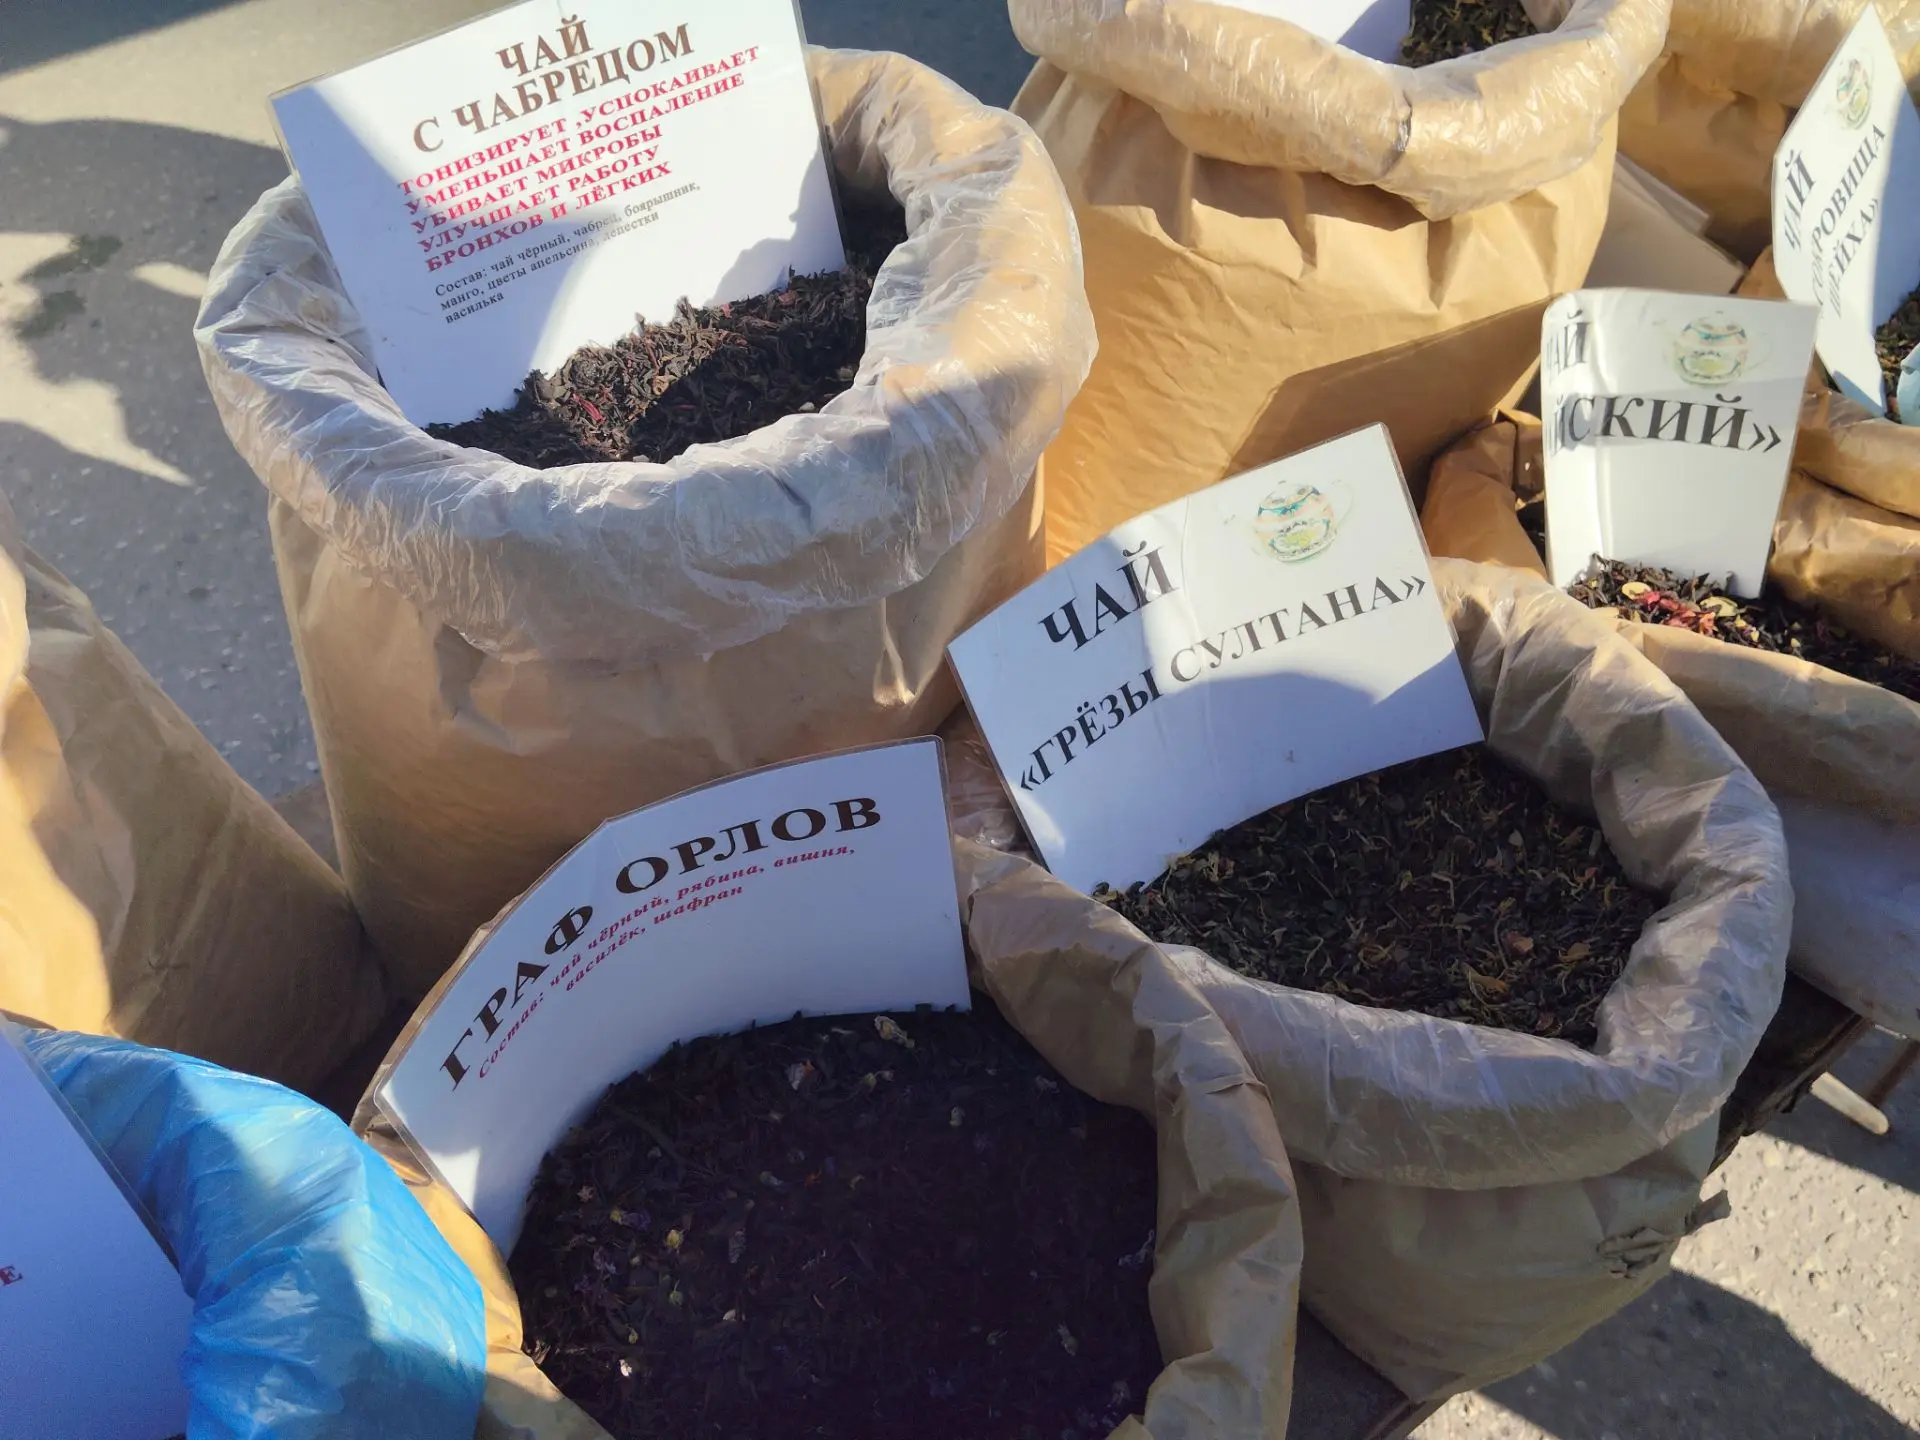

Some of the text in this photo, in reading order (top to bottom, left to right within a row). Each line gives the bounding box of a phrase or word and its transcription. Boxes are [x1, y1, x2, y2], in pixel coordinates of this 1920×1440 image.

[413, 23, 695, 152] С ЧАБРЕЦОМ
[495, 14, 594, 77] ЧАЙ
[398, 118, 567, 196] ТОНИЗИРУЕТ
[404, 73, 745, 215] УМЕНЬШАЕТ ВОСПАЛЕНИЕ
[411, 124, 663, 234] УБИВАЕТ МИКРОБЫ
[418, 145, 659, 252] УЛУЧШАЕТ РАБОТУ
[425, 161, 672, 272] БРОНХОВ И ЛЁГКИХ
[435, 268, 488, 297] Состав:
[490, 255, 514, 273] чай
[517, 232, 571, 262] чёрный,
[624, 181, 701, 217] боярышник,
[440, 287, 484, 311] манго,
[487, 267, 527, 291] цветы
[446, 292, 504, 324] василька
[1038, 541, 1180, 651] ЧАЙ
[1020, 575, 1426, 791] «ГРЁЗЫ СУЛТАНА»
[439, 797, 881, 1091] ГРАФ ОРЛОВ
[479, 846, 855, 1078] Состав: чай чёрный, рябина, вишня,
[565, 886, 744, 992] василёк, шафран
